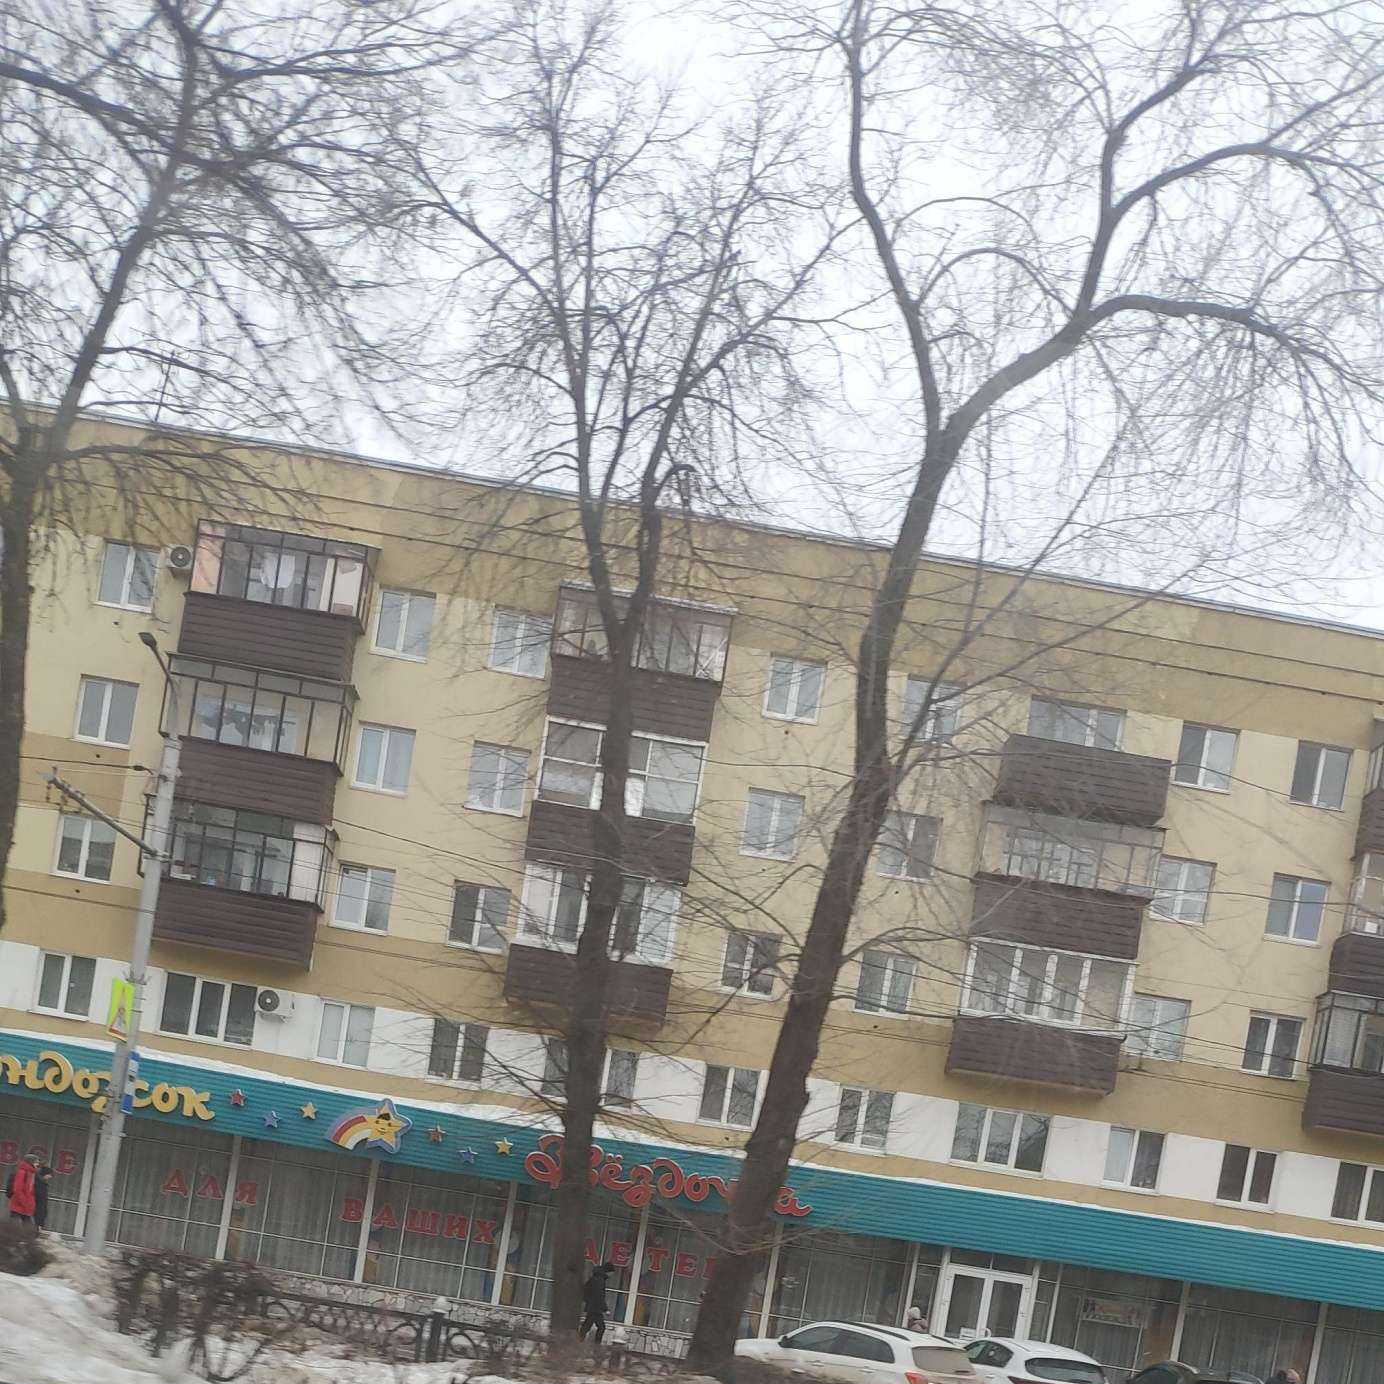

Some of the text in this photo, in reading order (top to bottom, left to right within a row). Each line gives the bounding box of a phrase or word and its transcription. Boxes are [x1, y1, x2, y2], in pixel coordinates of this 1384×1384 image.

[161, 1168, 257, 1206] ДЛЯ
[339, 1198, 497, 1245] ВАШИХ
[524, 1133, 813, 1217] Зёздоча
